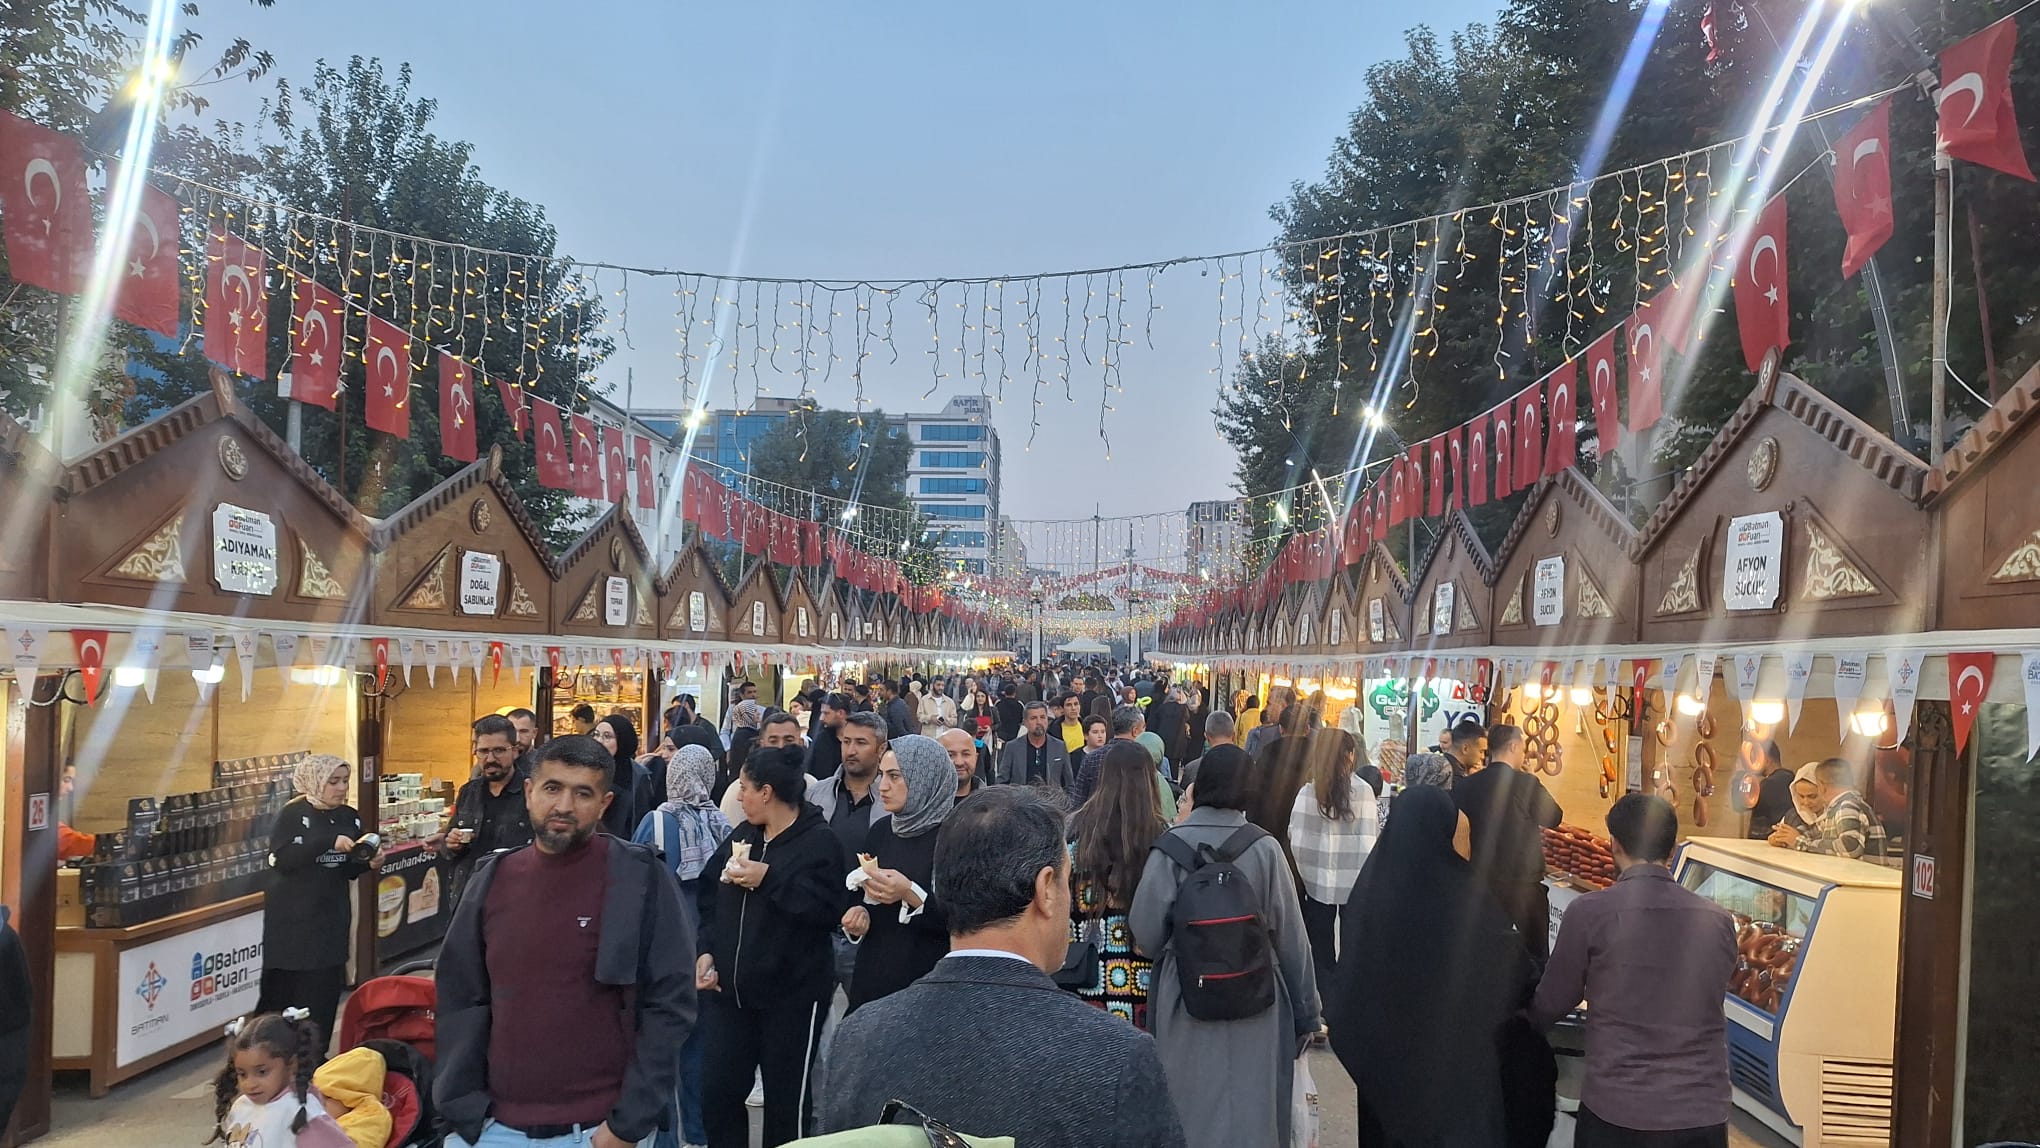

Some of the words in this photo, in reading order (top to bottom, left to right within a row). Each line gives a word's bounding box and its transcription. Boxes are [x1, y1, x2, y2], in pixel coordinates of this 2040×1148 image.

[220, 538, 271, 560] ADIYAMAN
[1736, 555, 1767, 574] AFYON
[1735, 580, 1766, 597] SUCUK
[32, 799, 44, 825] 26
[1916, 861, 1933, 892] 102
[215, 944, 264, 971] Batman
[215, 968, 248, 993] Fuarı
